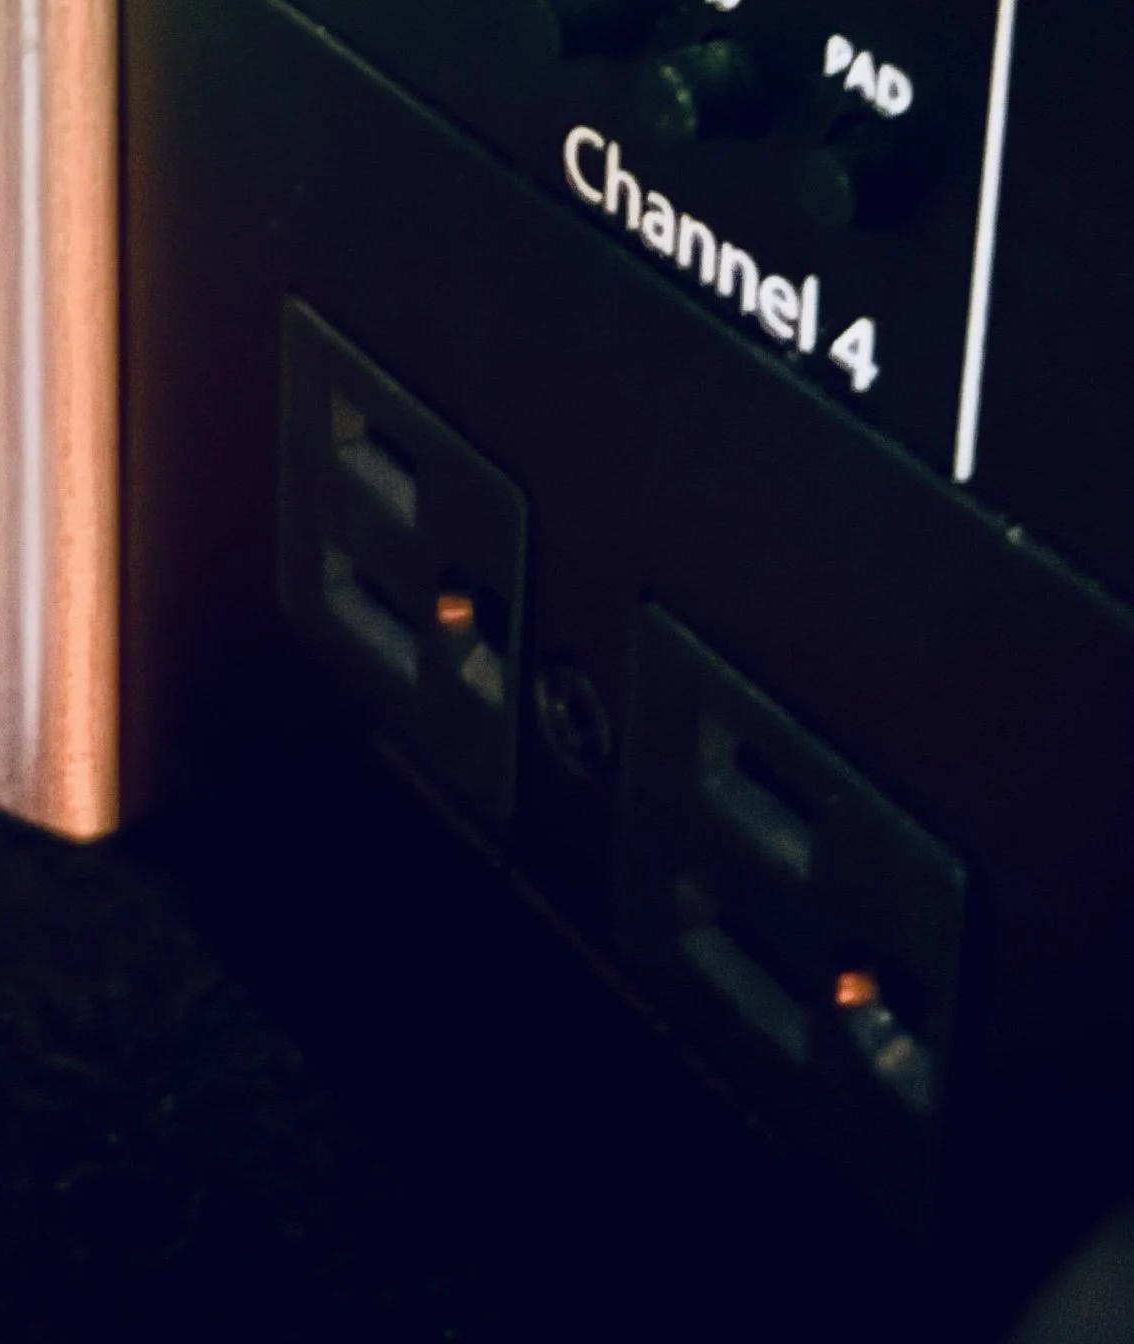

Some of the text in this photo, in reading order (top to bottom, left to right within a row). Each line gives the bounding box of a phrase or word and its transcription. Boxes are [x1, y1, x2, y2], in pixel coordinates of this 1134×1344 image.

[822, 33, 914, 117] PAD
[564, 125, 880, 393] Channel 4
